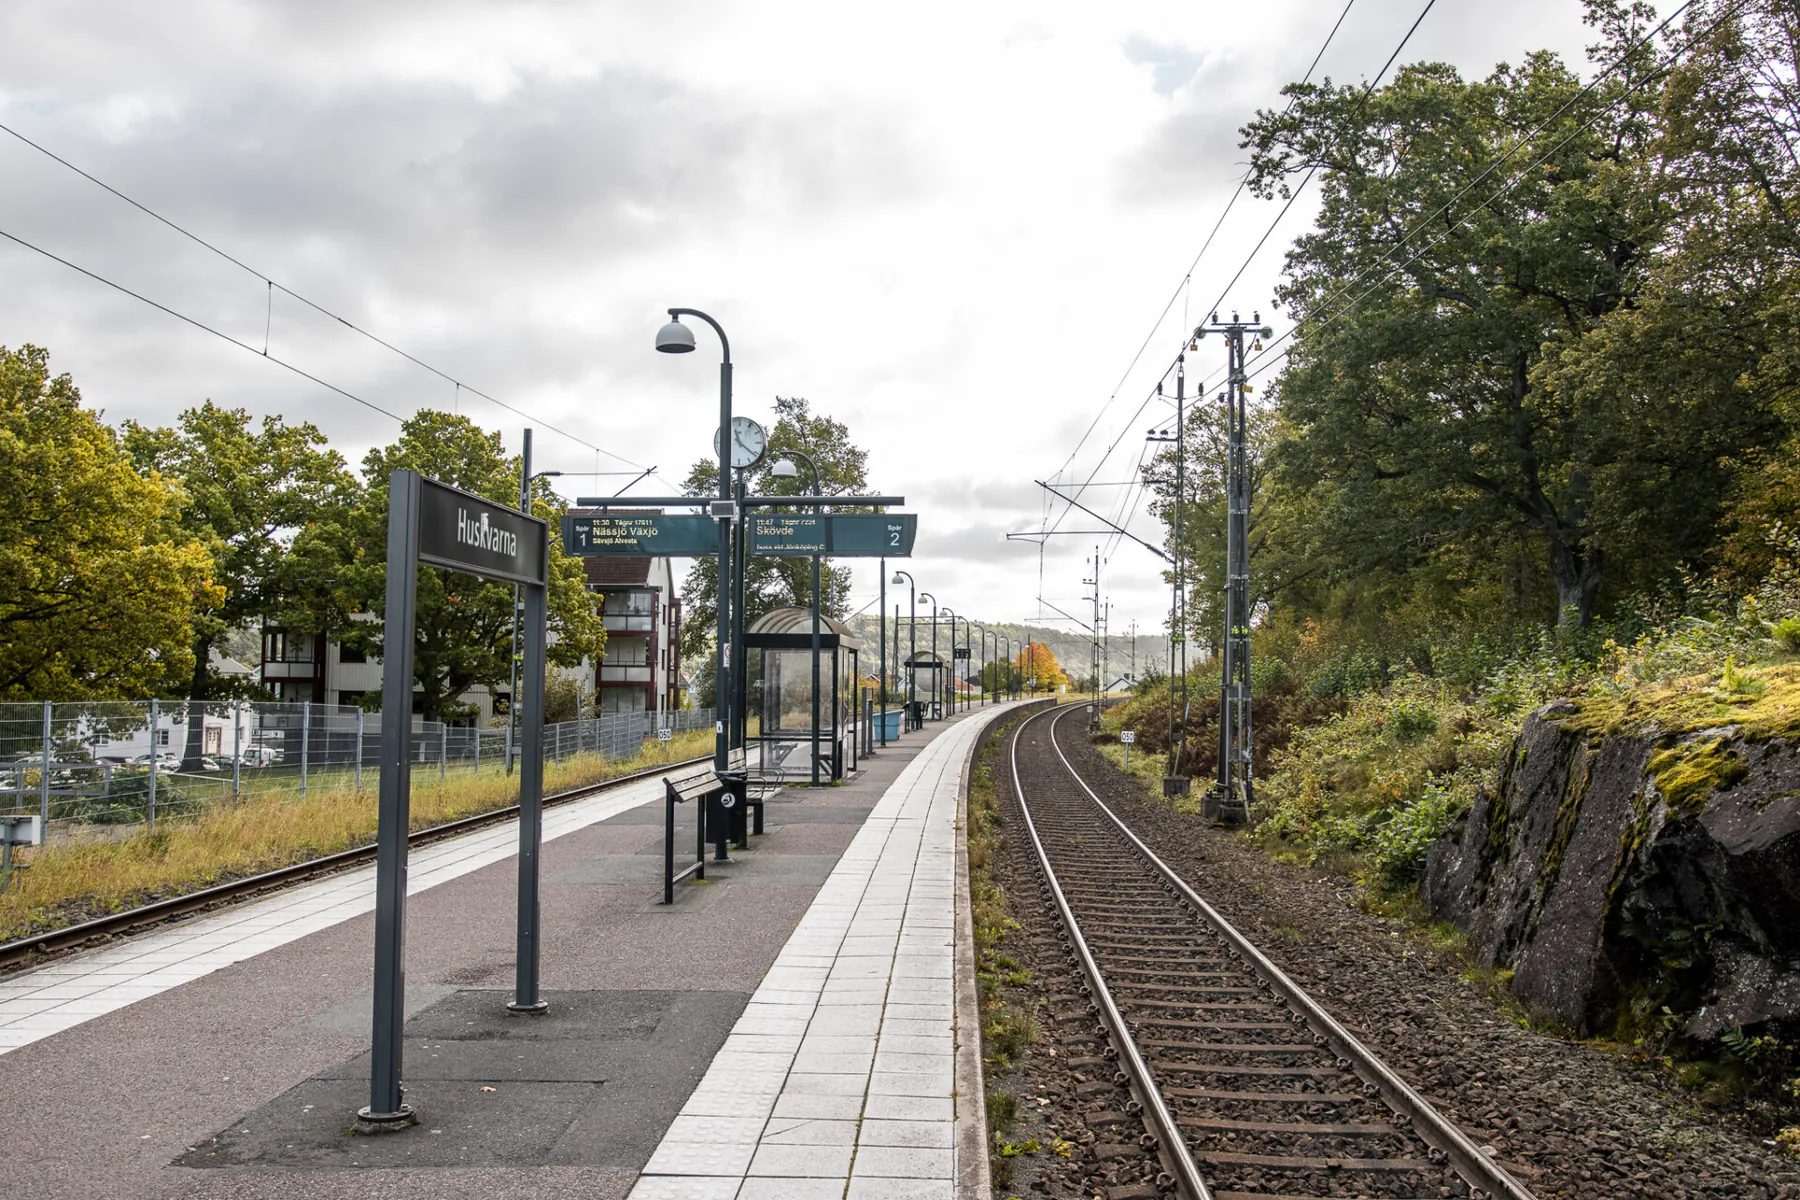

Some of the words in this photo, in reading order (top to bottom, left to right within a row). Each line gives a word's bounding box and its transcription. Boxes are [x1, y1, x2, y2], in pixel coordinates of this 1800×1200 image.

[457, 507, 517, 557] Huskvarna
[592, 527, 627, 537] Nässjö
[630, 527, 658, 537] Växjö
[756, 526, 794, 535] Skövde
[580, 533, 586, 547] 1
[890, 532, 900, 546] 2
[658, 730, 671, 739] 050
[1121, 732, 1134, 741] 050
